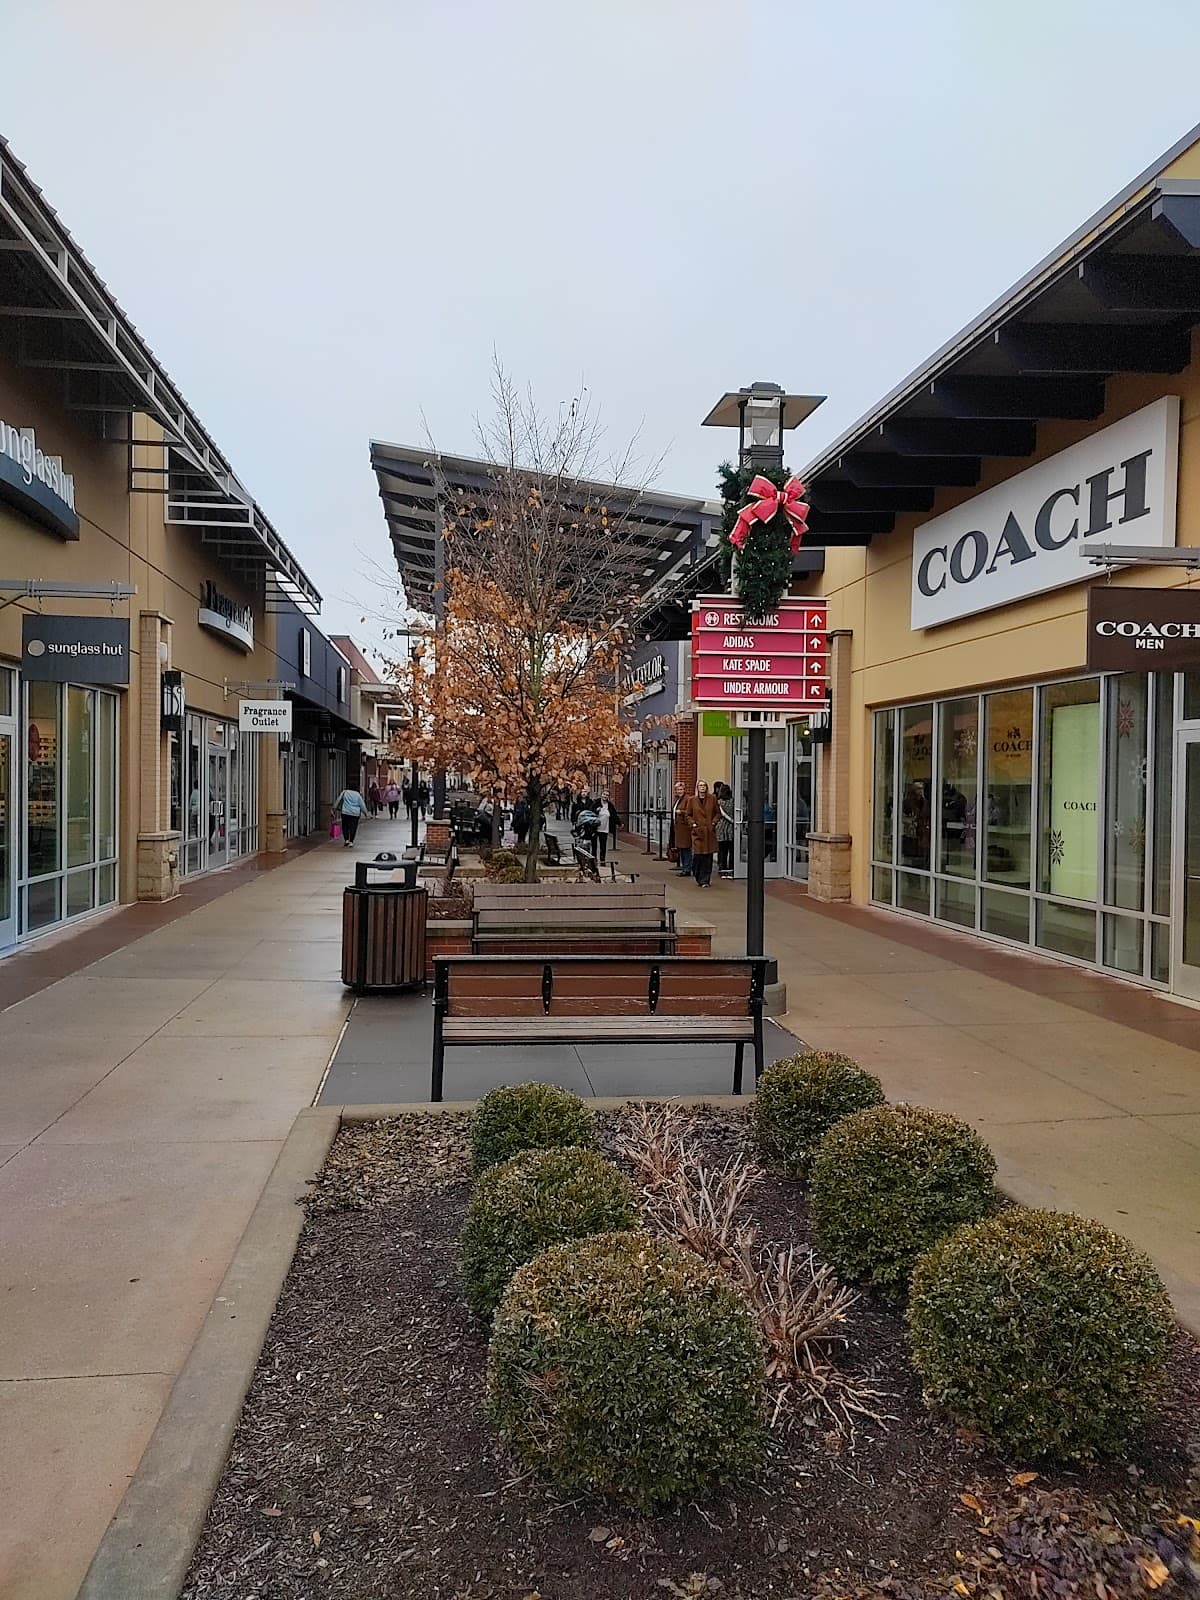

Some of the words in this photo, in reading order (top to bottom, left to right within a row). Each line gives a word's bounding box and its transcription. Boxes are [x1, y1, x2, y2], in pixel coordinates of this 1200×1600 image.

[917, 449, 1152, 597] COACH
[1095, 621, 1200, 638] COACH
[723, 635, 755, 648] ADIDAS
[1135, 639, 1164, 649] MEN
[48, 642, 101, 657] sunglass
[102, 642, 123, 656] hut
[723, 658, 743, 671] KATE
[745, 659, 771, 672] SPADE
[723, 682, 751, 694] UNDER
[753, 682, 789, 695] ARMOUR
[243, 706, 287, 717] Fragrance
[252, 717, 279, 726] Outlet
